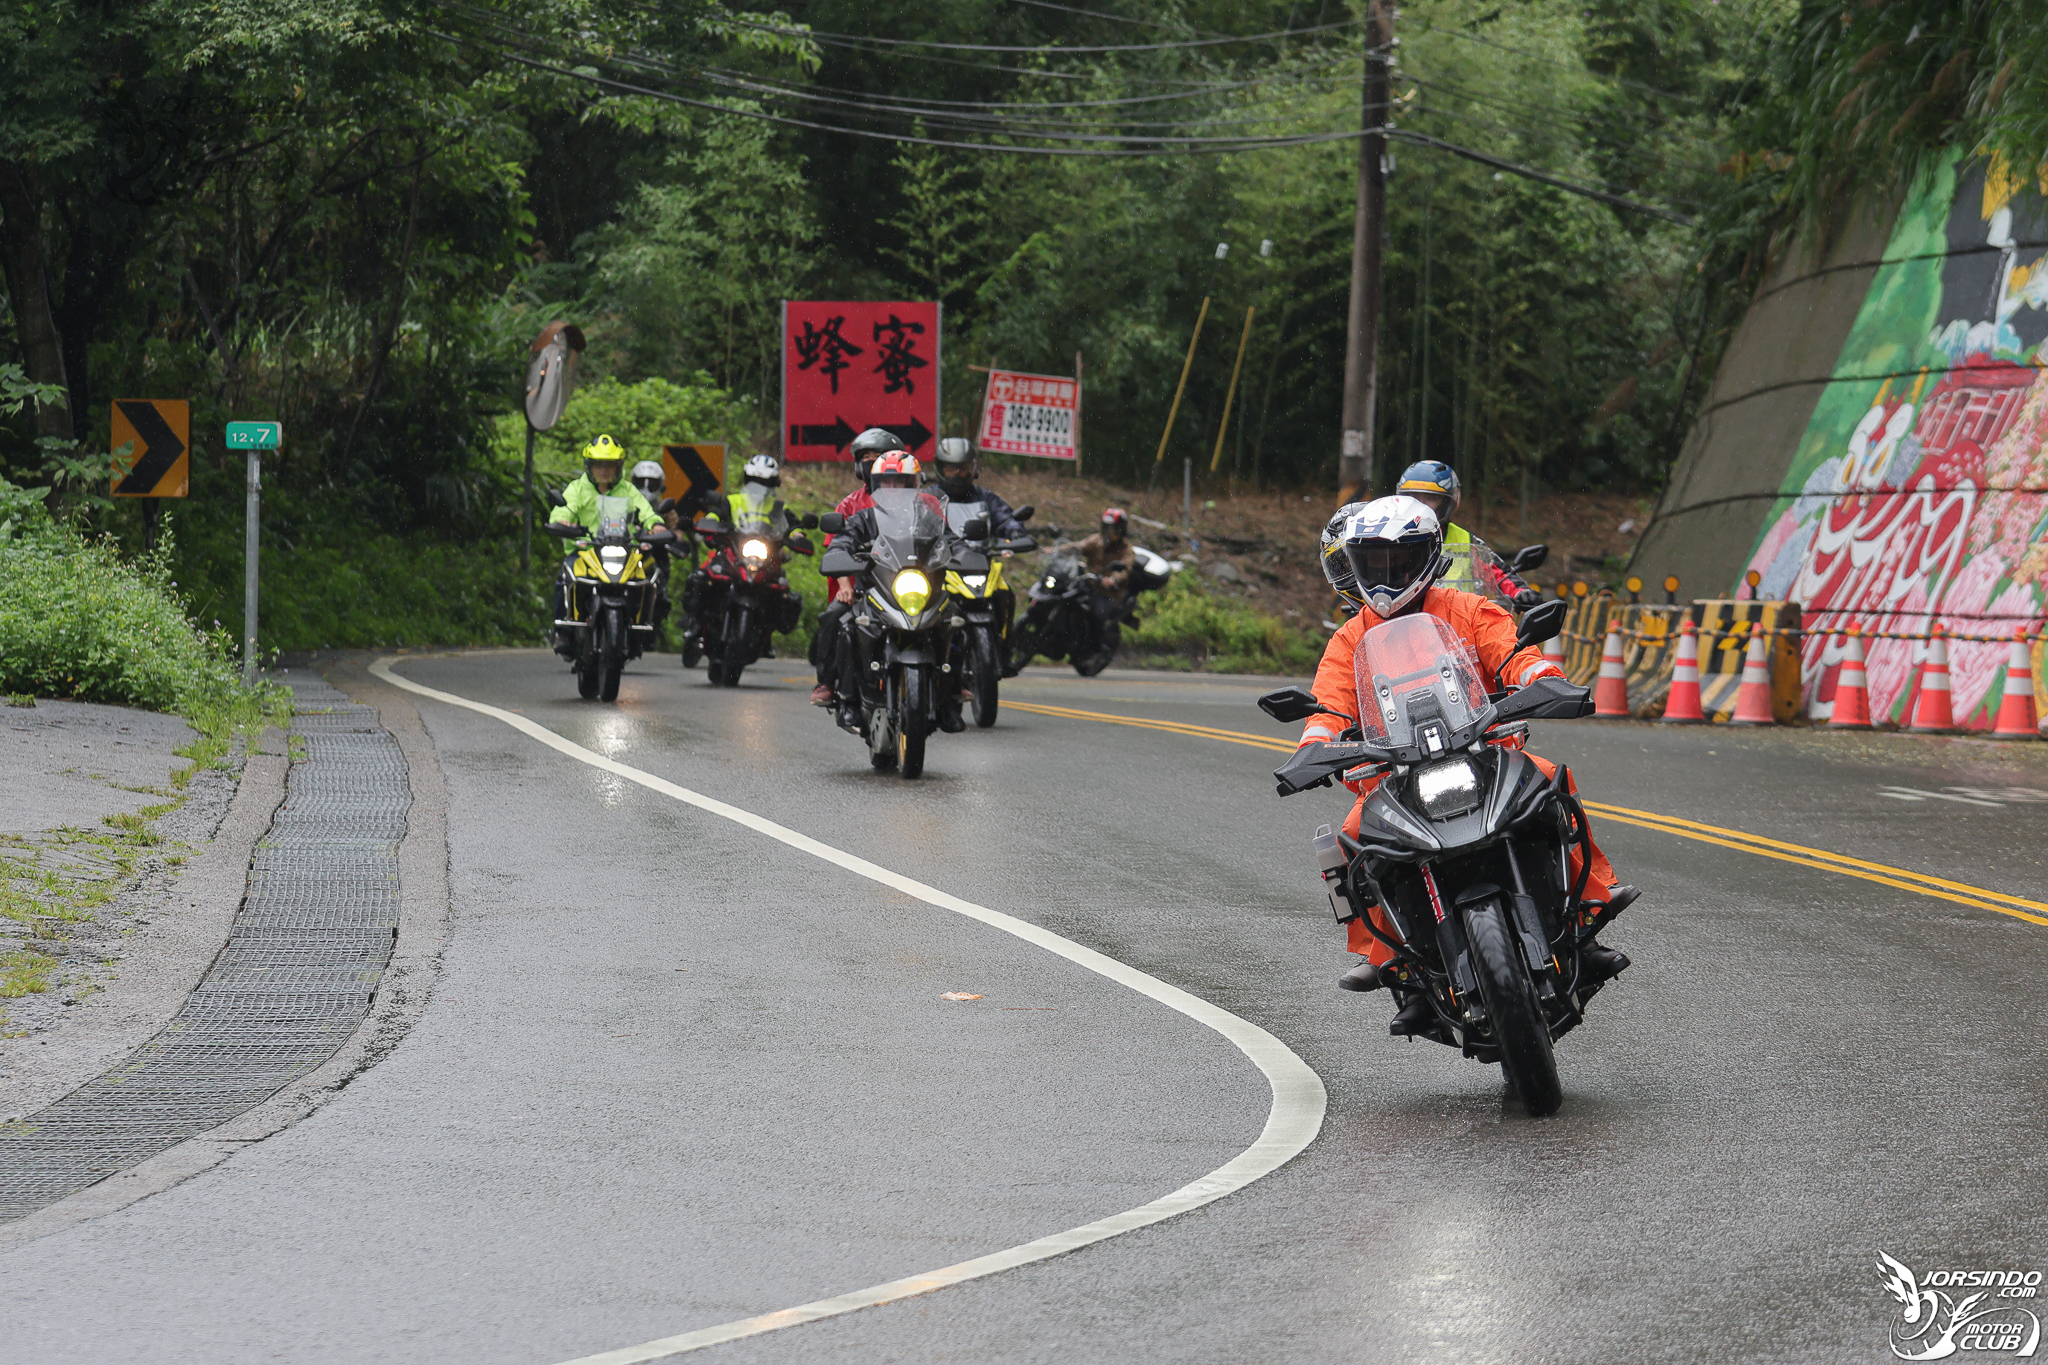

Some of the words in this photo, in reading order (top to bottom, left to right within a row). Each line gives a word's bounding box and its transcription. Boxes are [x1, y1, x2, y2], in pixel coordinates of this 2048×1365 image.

[795, 314, 929, 394] 蜂蜜
[1008, 404, 1070, 434] 368-9900
[232, 428, 271, 443] 12.7
